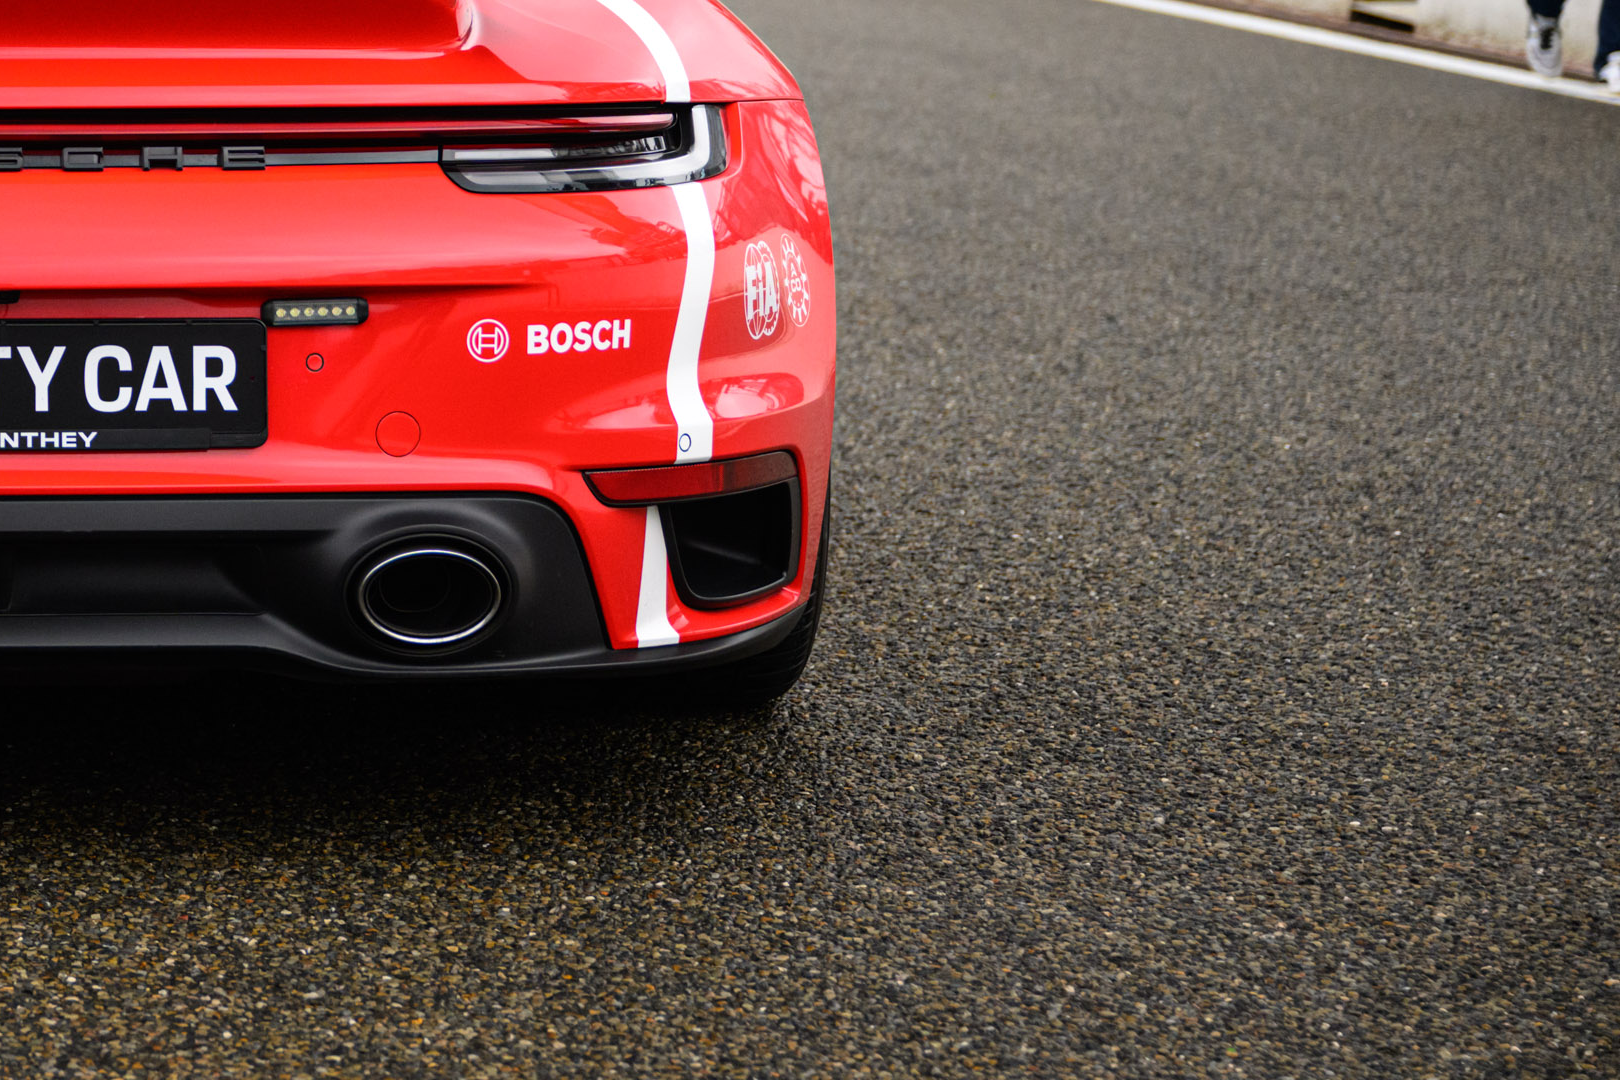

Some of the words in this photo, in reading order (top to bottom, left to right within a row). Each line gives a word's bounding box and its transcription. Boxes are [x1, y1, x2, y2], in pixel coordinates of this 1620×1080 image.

[745, 260, 778, 322] FIA
[526, 318, 631, 355] BOSCH
[83, 344, 239, 414] CAR
